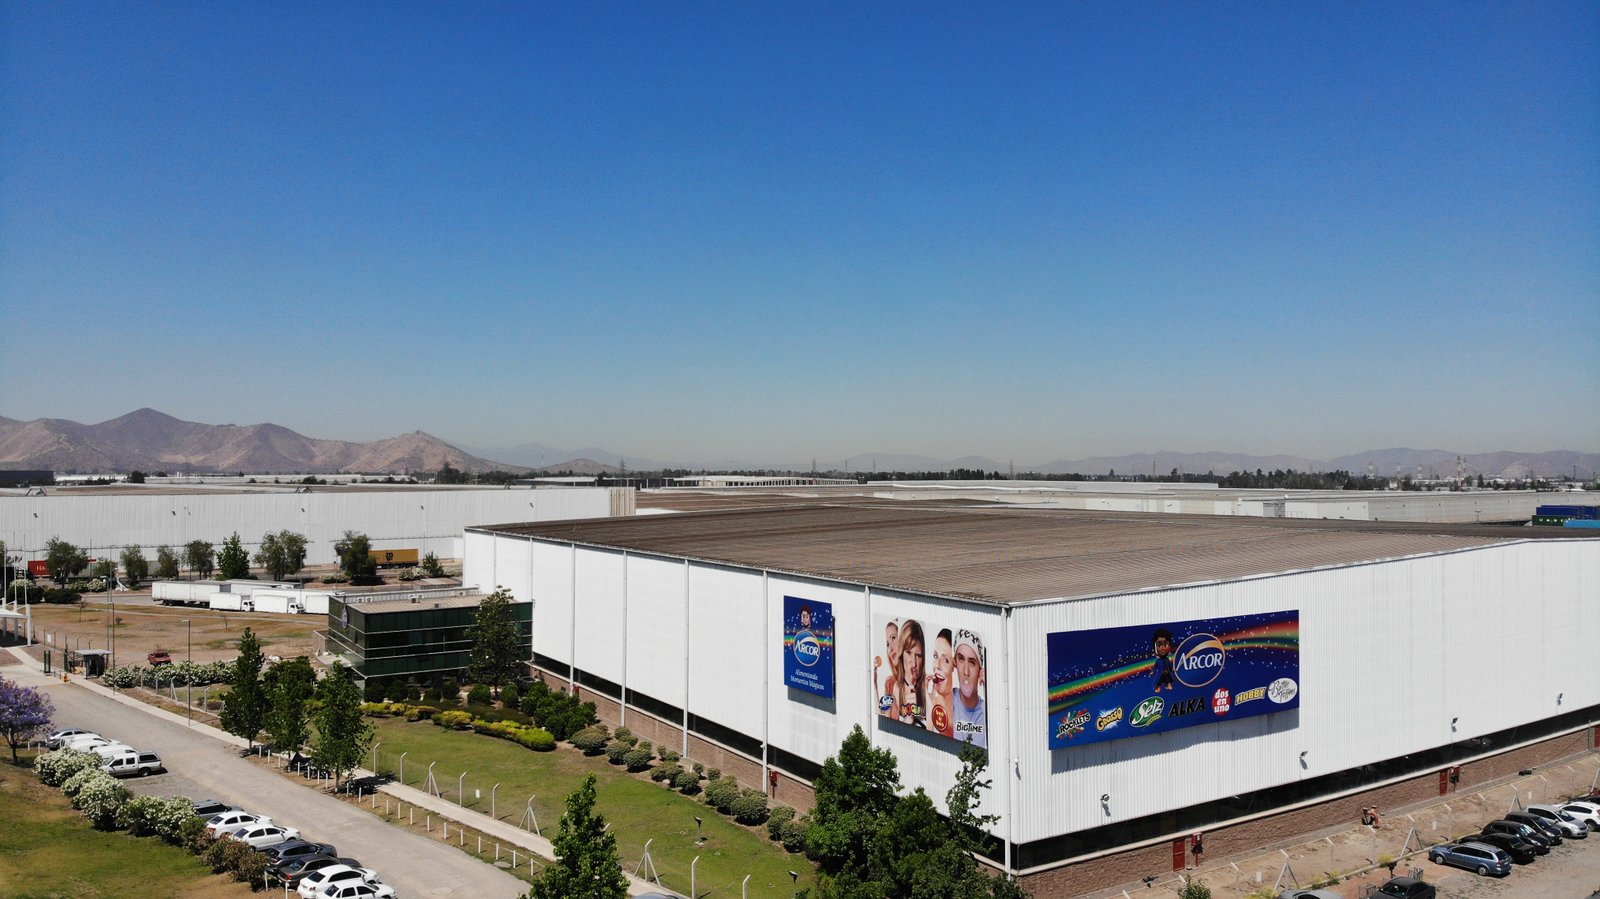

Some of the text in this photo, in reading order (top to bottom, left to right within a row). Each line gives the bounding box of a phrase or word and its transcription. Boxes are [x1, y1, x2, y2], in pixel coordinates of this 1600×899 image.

[793, 640, 820, 657] ARCOR
[1175, 652, 1223, 672] ARCOR
[1214, 688, 1229, 699] dos
[1216, 697, 1227, 706] en
[1235, 688, 1266, 704] HOBBY
[1131, 699, 1163, 725] Selz
[1168, 698, 1204, 718] ALKA
[1213, 704, 1229, 713] uno
[1058, 712, 1091, 735] ROCKLETS
